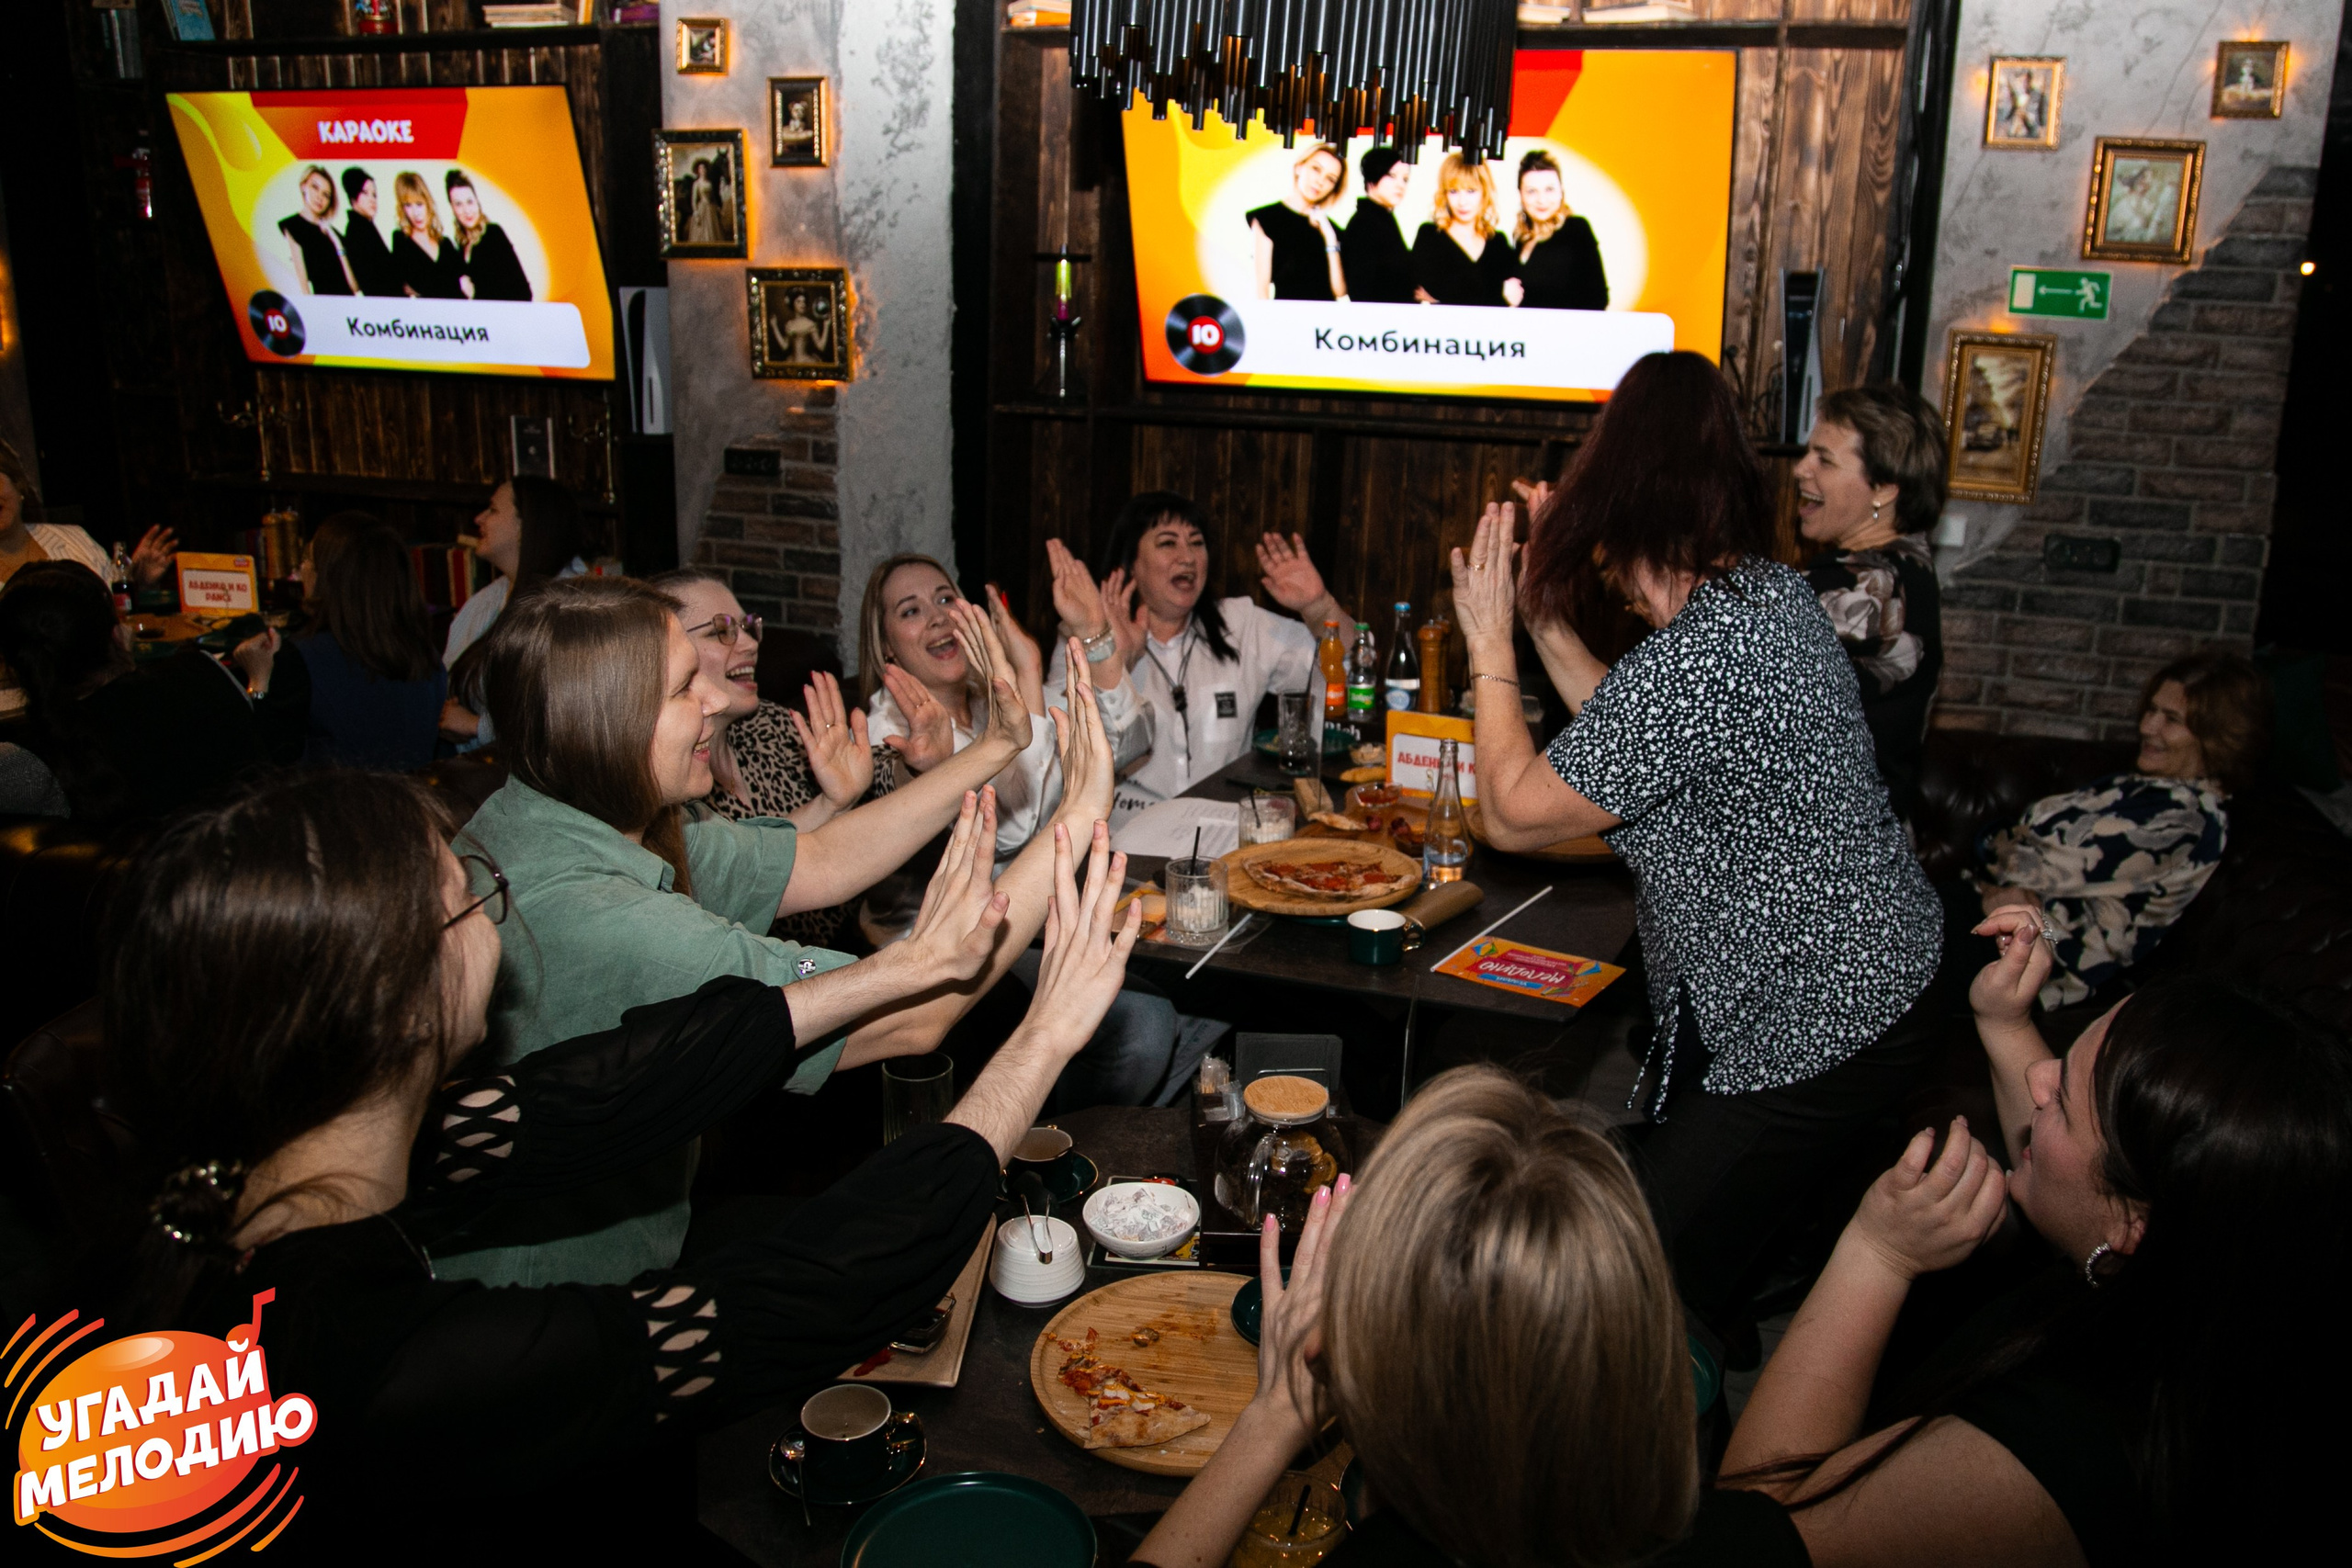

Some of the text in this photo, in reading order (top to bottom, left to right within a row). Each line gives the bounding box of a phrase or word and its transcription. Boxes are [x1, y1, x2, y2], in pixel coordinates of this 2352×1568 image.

[318, 118, 414, 144] КАРАОКЕ
[346, 316, 490, 344] Комбинация
[1314, 327, 1527, 361] Комбинация
